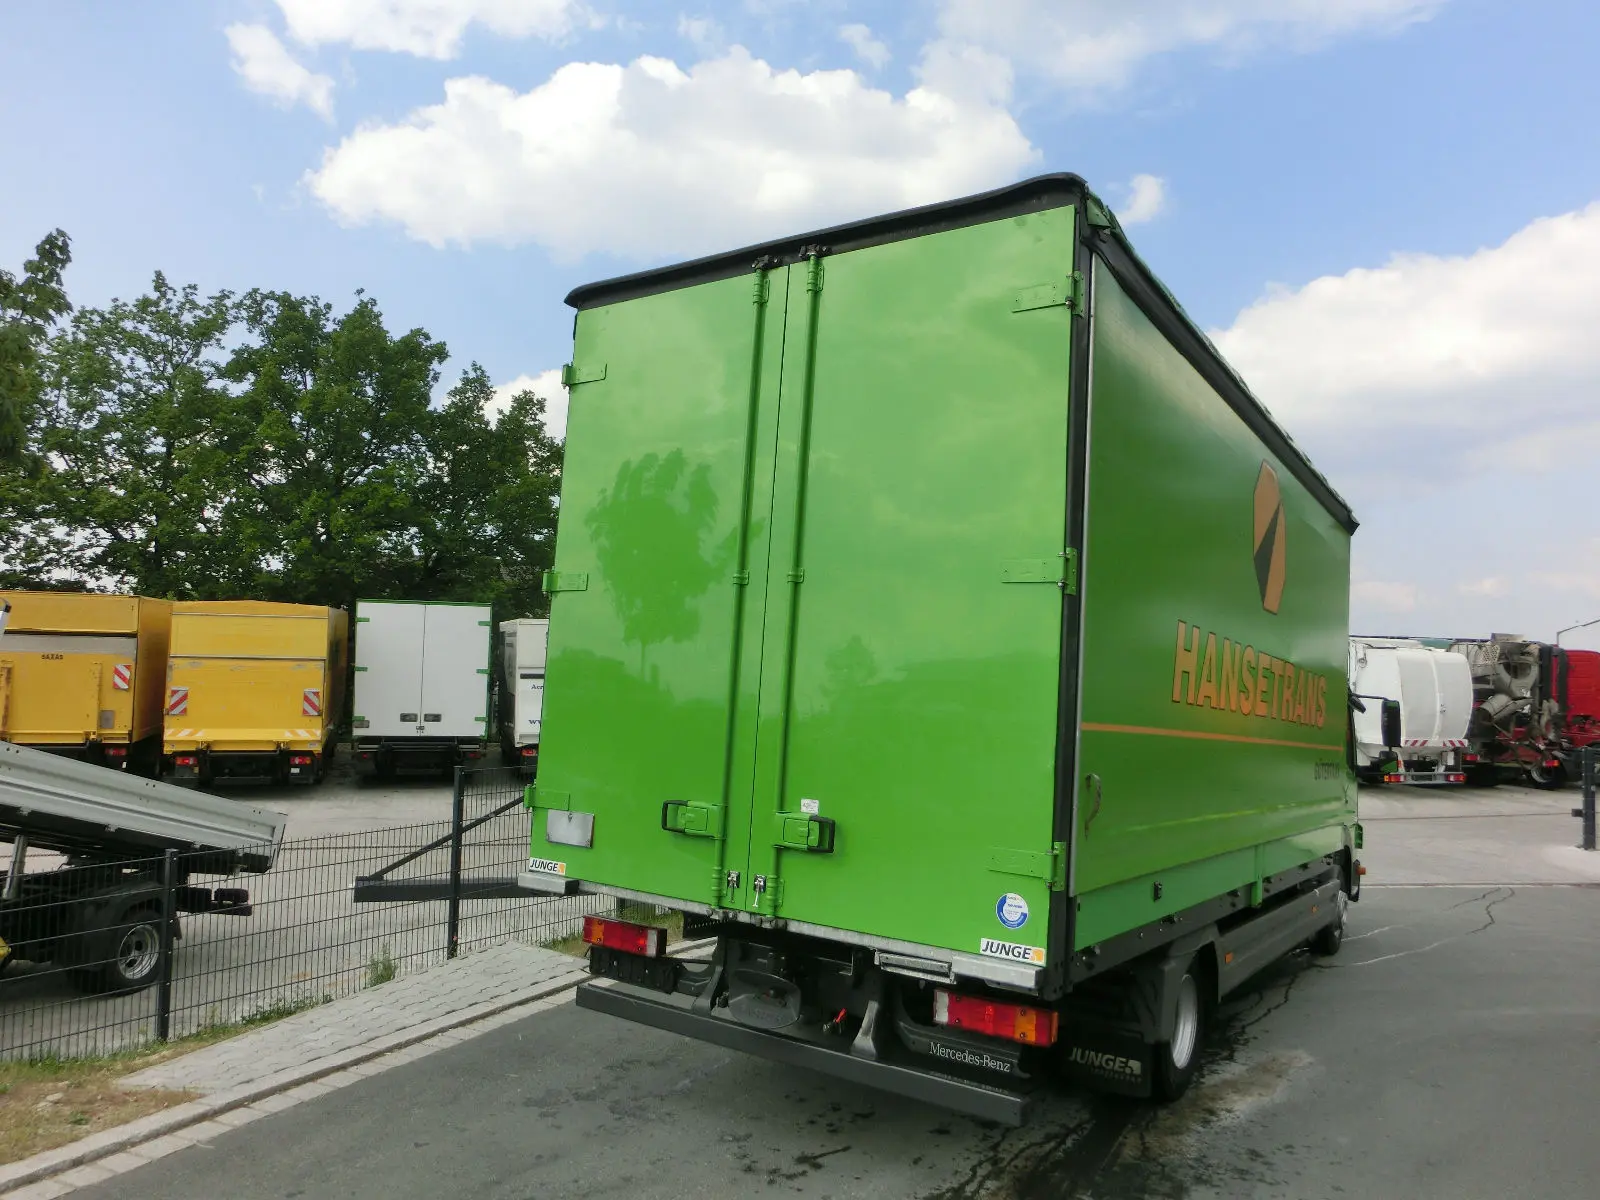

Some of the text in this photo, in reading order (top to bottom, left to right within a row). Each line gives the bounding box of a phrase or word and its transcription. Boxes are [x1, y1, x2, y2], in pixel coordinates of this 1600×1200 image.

[1172, 619, 1327, 729] HANSETRANS
[530, 859, 558, 872] JUNGE
[982, 941, 1032, 960] JUNGE
[929, 1041, 1011, 1072] Mercedes-Benz
[1068, 1047, 1127, 1072] JUNGE
